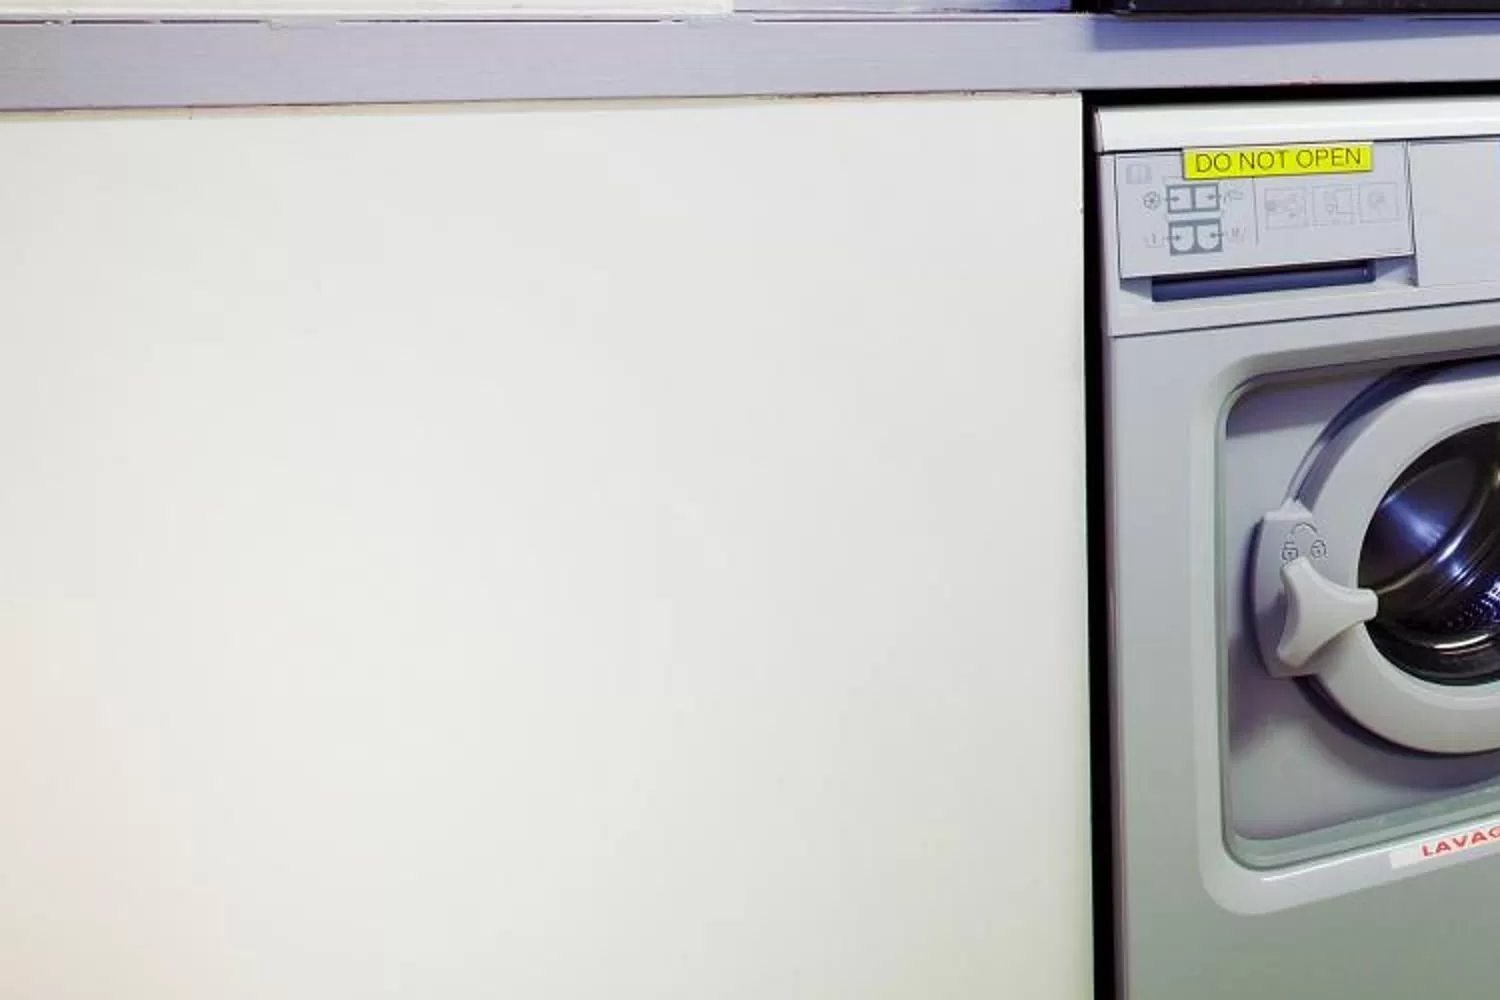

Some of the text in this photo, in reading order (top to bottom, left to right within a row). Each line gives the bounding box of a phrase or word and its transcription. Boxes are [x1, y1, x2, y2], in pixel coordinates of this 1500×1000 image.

[1194, 147, 1362, 174] DO NOT OPEN
